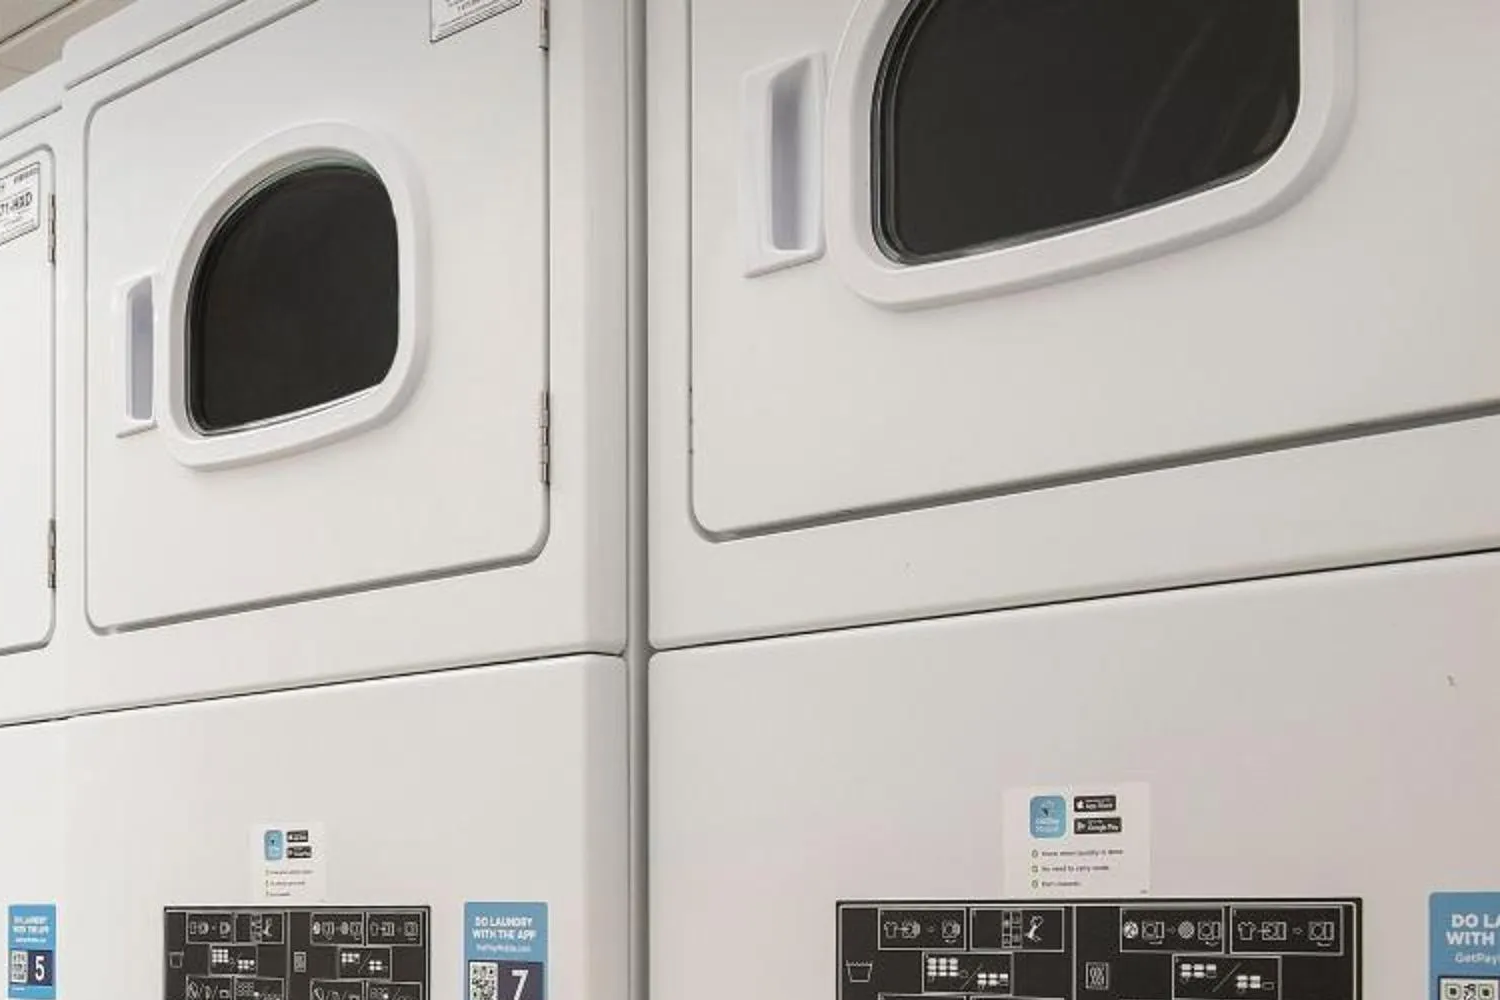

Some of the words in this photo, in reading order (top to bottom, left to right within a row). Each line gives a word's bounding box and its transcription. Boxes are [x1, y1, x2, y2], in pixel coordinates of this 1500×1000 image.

[1451, 914, 1478, 928] DO
[1445, 931, 1495, 946] WITH
[35, 955, 45, 981] 5
